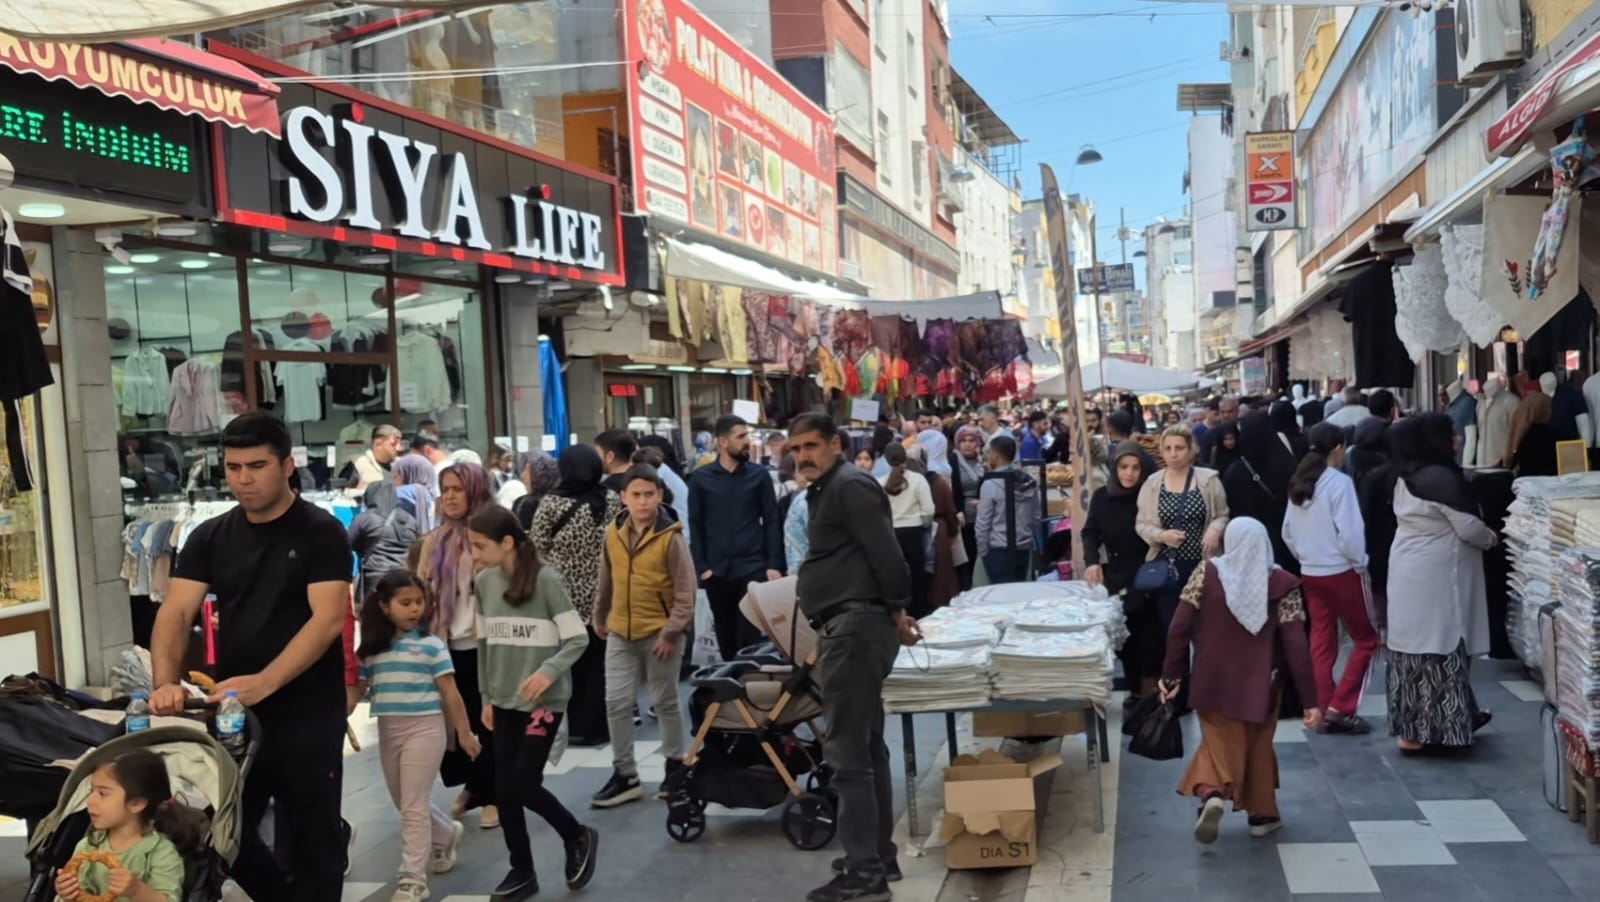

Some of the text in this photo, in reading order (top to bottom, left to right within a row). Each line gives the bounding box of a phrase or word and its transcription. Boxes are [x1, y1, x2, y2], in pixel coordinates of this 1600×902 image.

[0, 105, 190, 174] RE İNDİRİM
[286, 102, 606, 270] SİYA LİFE
[980, 847, 1004, 859] DIA
